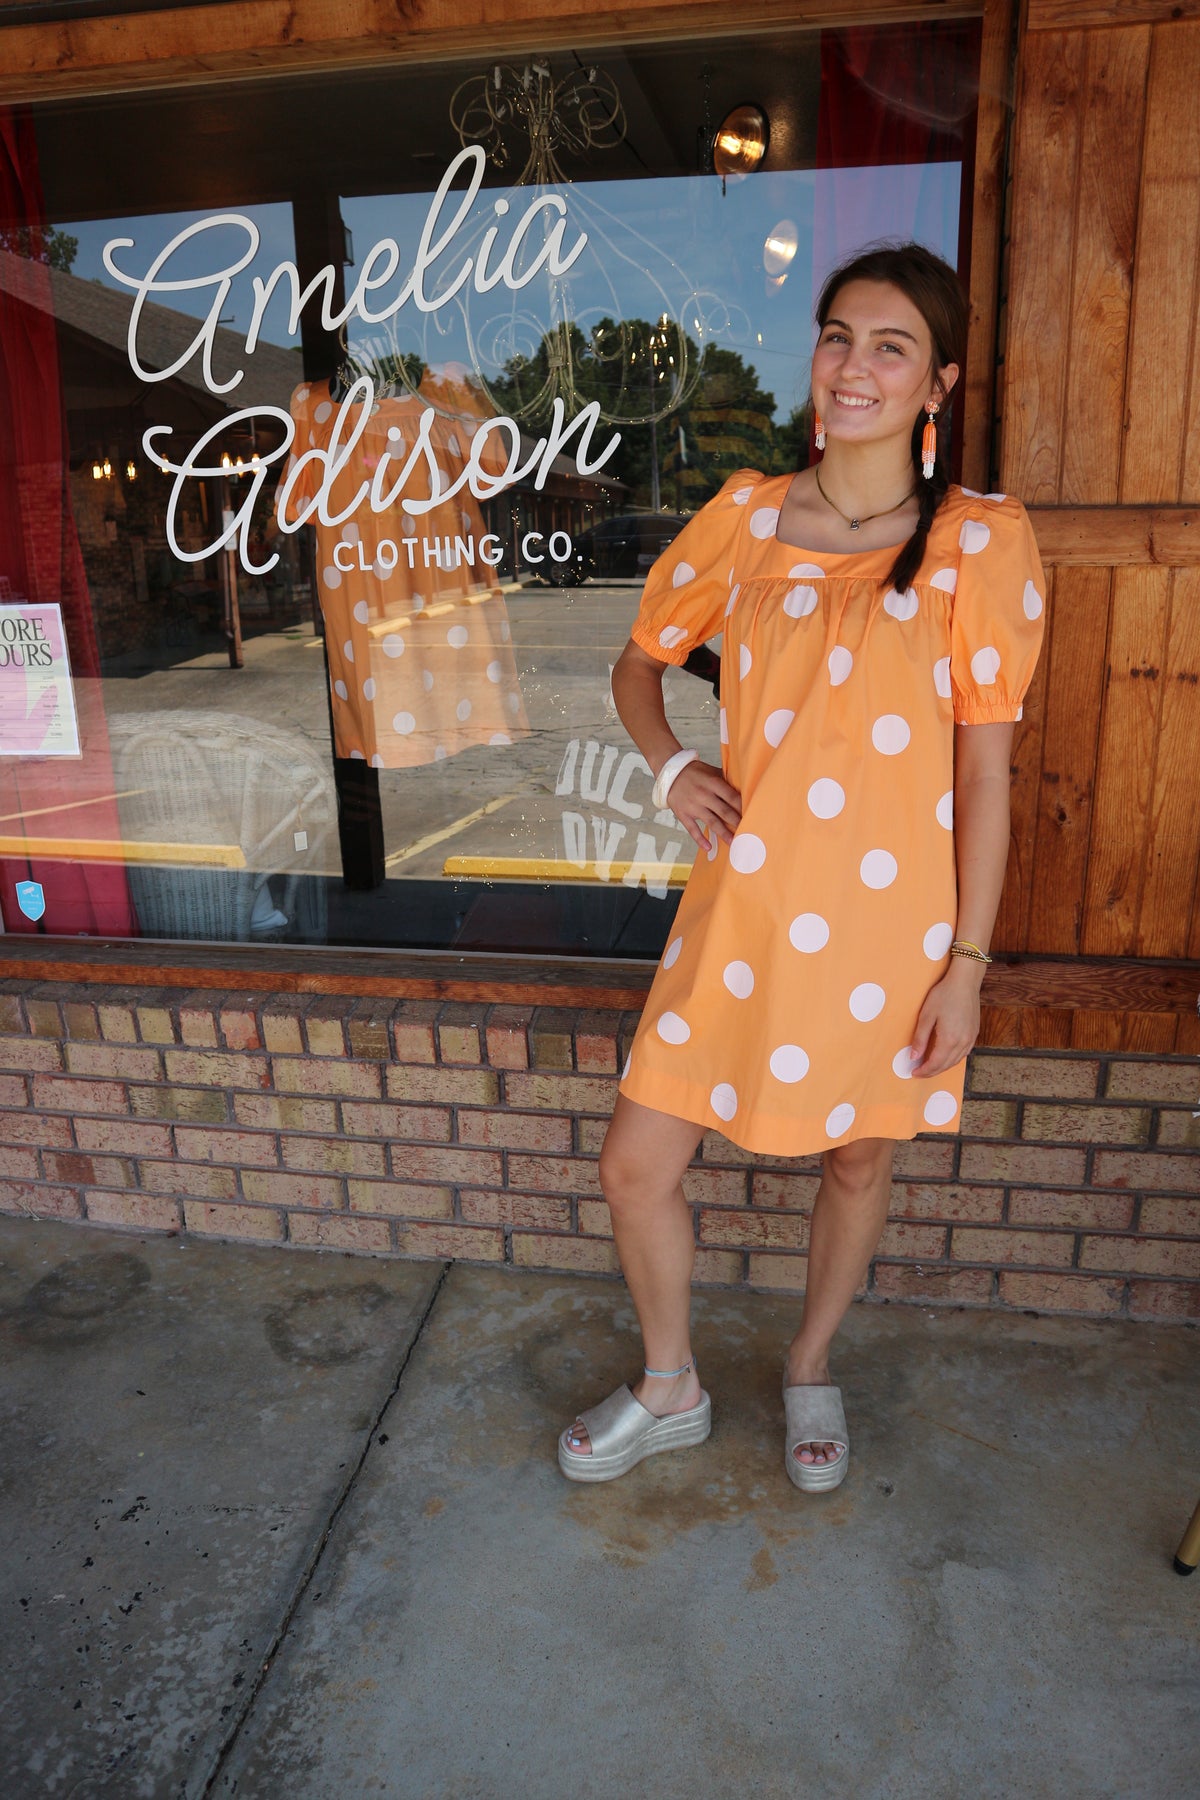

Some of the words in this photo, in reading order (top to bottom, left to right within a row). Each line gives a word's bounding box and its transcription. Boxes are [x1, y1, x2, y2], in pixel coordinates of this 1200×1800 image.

[102, 144, 588, 394] Amelia
[142, 376, 622, 576] Adison
[332, 533, 504, 573] CLOTHING
[521, 530, 584, 563] CO.
[0, 618, 46, 642] ORE
